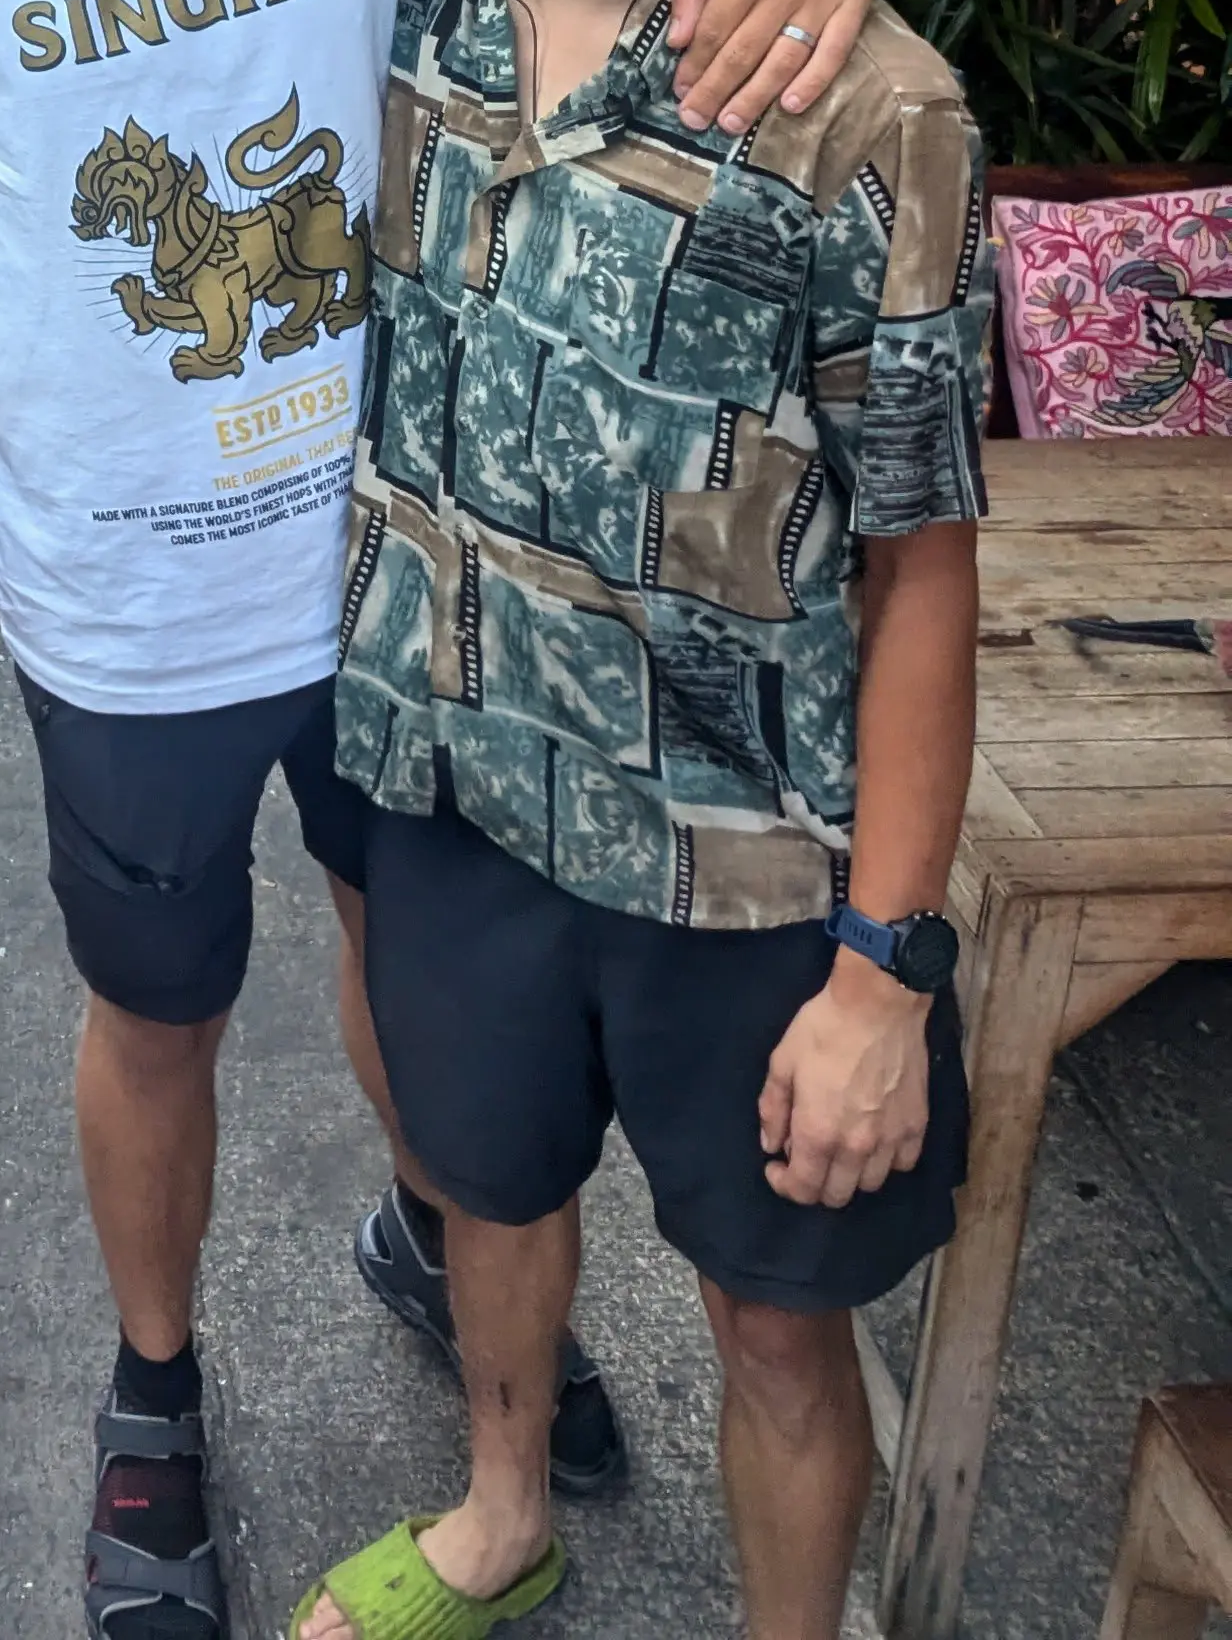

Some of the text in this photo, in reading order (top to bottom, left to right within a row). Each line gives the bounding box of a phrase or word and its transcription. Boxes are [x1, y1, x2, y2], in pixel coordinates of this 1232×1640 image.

[287, 376, 350, 423] 1933
[92, 509, 121, 522] MADE
[121, 506, 147, 520] WITH
[150, 506, 158, 517] A
[159, 500, 215, 516] SIGNATURE
[216, 494, 249, 511] BLEND
[251, 471, 309, 501] COMPRISING
[311, 467, 322, 479] OF
[324, 454, 351, 473] 100%
[213, 474, 239, 491] THE
[243, 452, 305, 485] ORIGINAL
[151, 519, 183, 532] USING
[184, 519, 203, 530] THE
[205, 508, 252, 527] WORLD'S
[253, 495, 285, 516] FINEST
[286, 485, 313, 504] HOPS
[313, 476, 337, 493] WITH
[171, 532, 206, 546] COMES
[207, 529, 227, 541] THE
[229, 521, 256, 538] MOST
[257, 508, 289, 529] ICONIC
[290, 497, 319, 517] TASTE
[320, 491, 331, 506] OF
